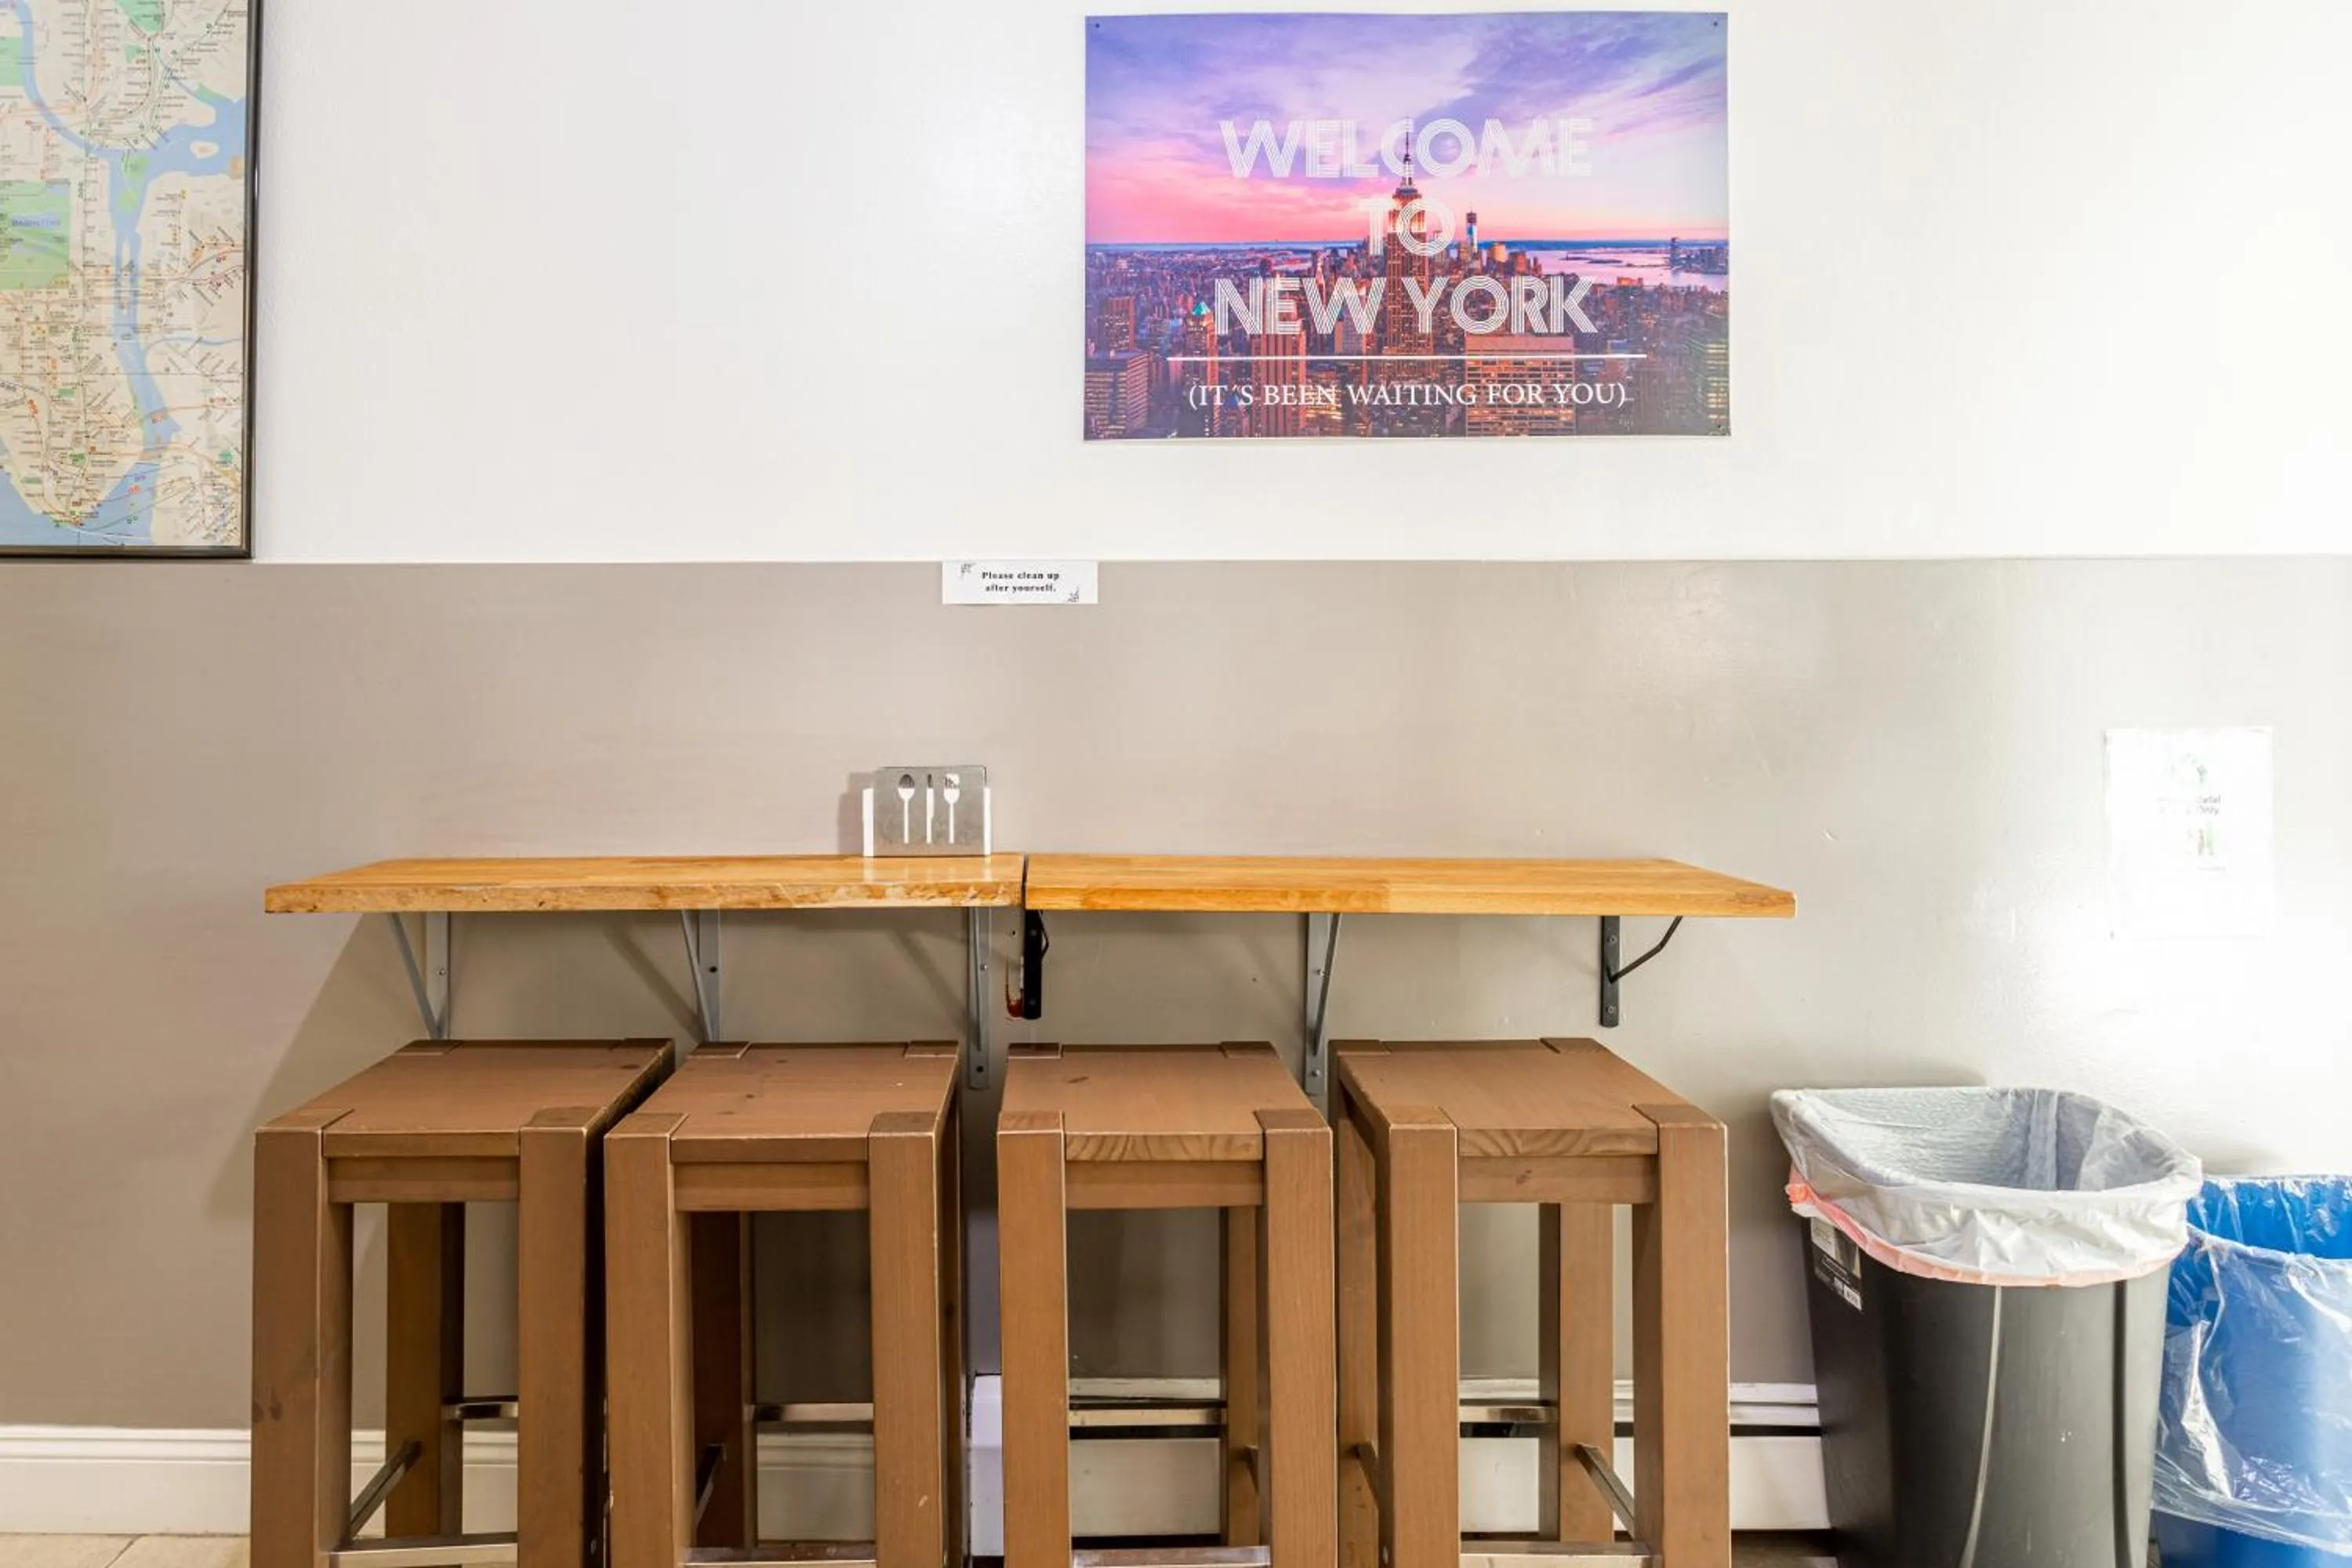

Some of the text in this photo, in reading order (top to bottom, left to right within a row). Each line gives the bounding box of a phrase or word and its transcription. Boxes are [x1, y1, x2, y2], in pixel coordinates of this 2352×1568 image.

[1218, 118, 1593, 178] WELCOME
[1359, 198, 1456, 256] TO
[1214, 275, 1599, 336] NEW YORK
[1264, 384, 1337, 406] BEEN
[1346, 383, 1477, 406] WAITING
[1489, 383, 1546, 406] FOR
[1553, 382, 1627, 408] YOU)
[985, 583, 1056, 593] after yourself.
